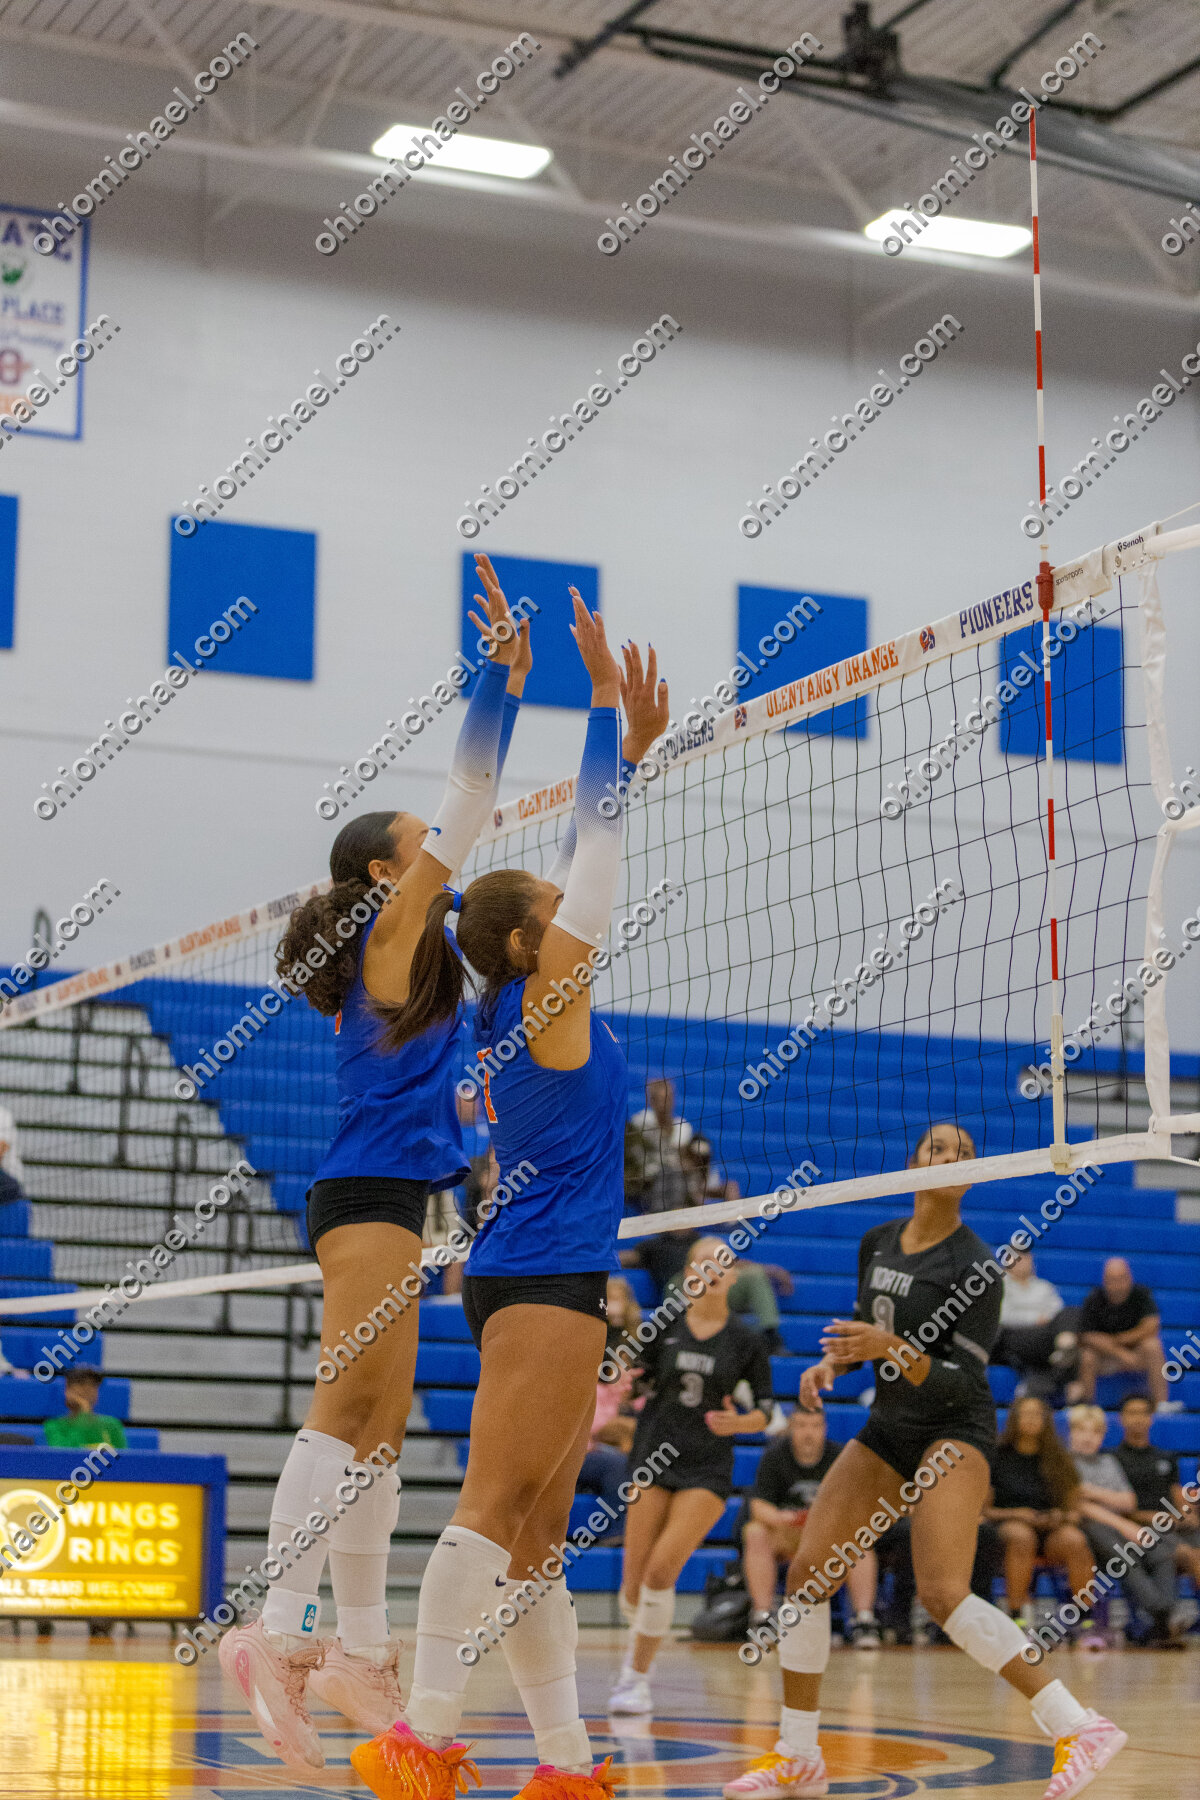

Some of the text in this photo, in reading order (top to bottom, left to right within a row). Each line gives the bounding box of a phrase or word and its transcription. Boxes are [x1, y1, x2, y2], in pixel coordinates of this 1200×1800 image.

[1122, 535, 1144, 550] Senoh
[959, 581, 1034, 638] PIONEERS
[766, 640, 899, 718] OLENTANGY ORANGE
[869, 1266, 914, 1297] NORTH
[679, 1372, 704, 1408] 3
[67, 1501, 180, 1530] WINGS
[68, 1537, 182, 1567] RINGS
